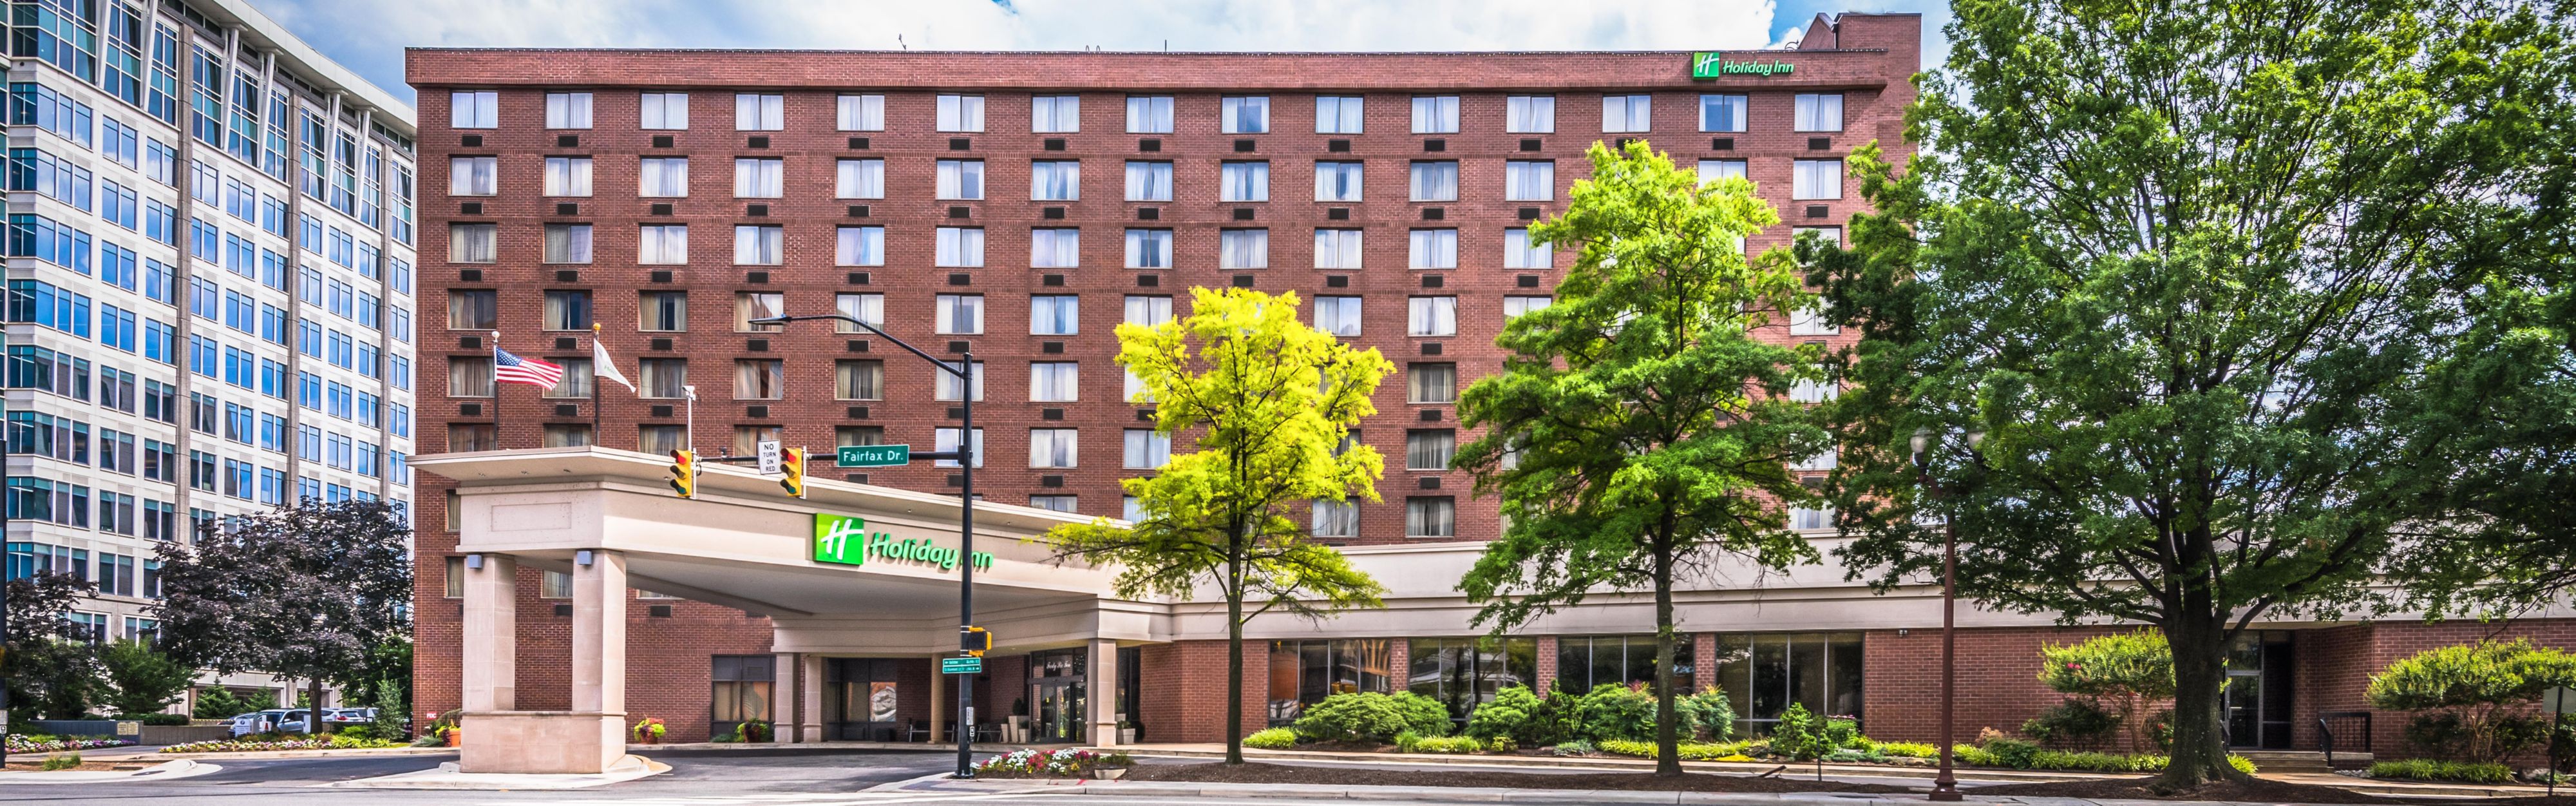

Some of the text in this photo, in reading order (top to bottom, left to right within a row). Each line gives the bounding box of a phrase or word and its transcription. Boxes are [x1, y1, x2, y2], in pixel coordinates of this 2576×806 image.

[1723, 59, 1794, 76] Holiday Inn
[844, 450, 904, 462] Fairfax Dr.
[869, 532, 994, 569] Holiday nn
